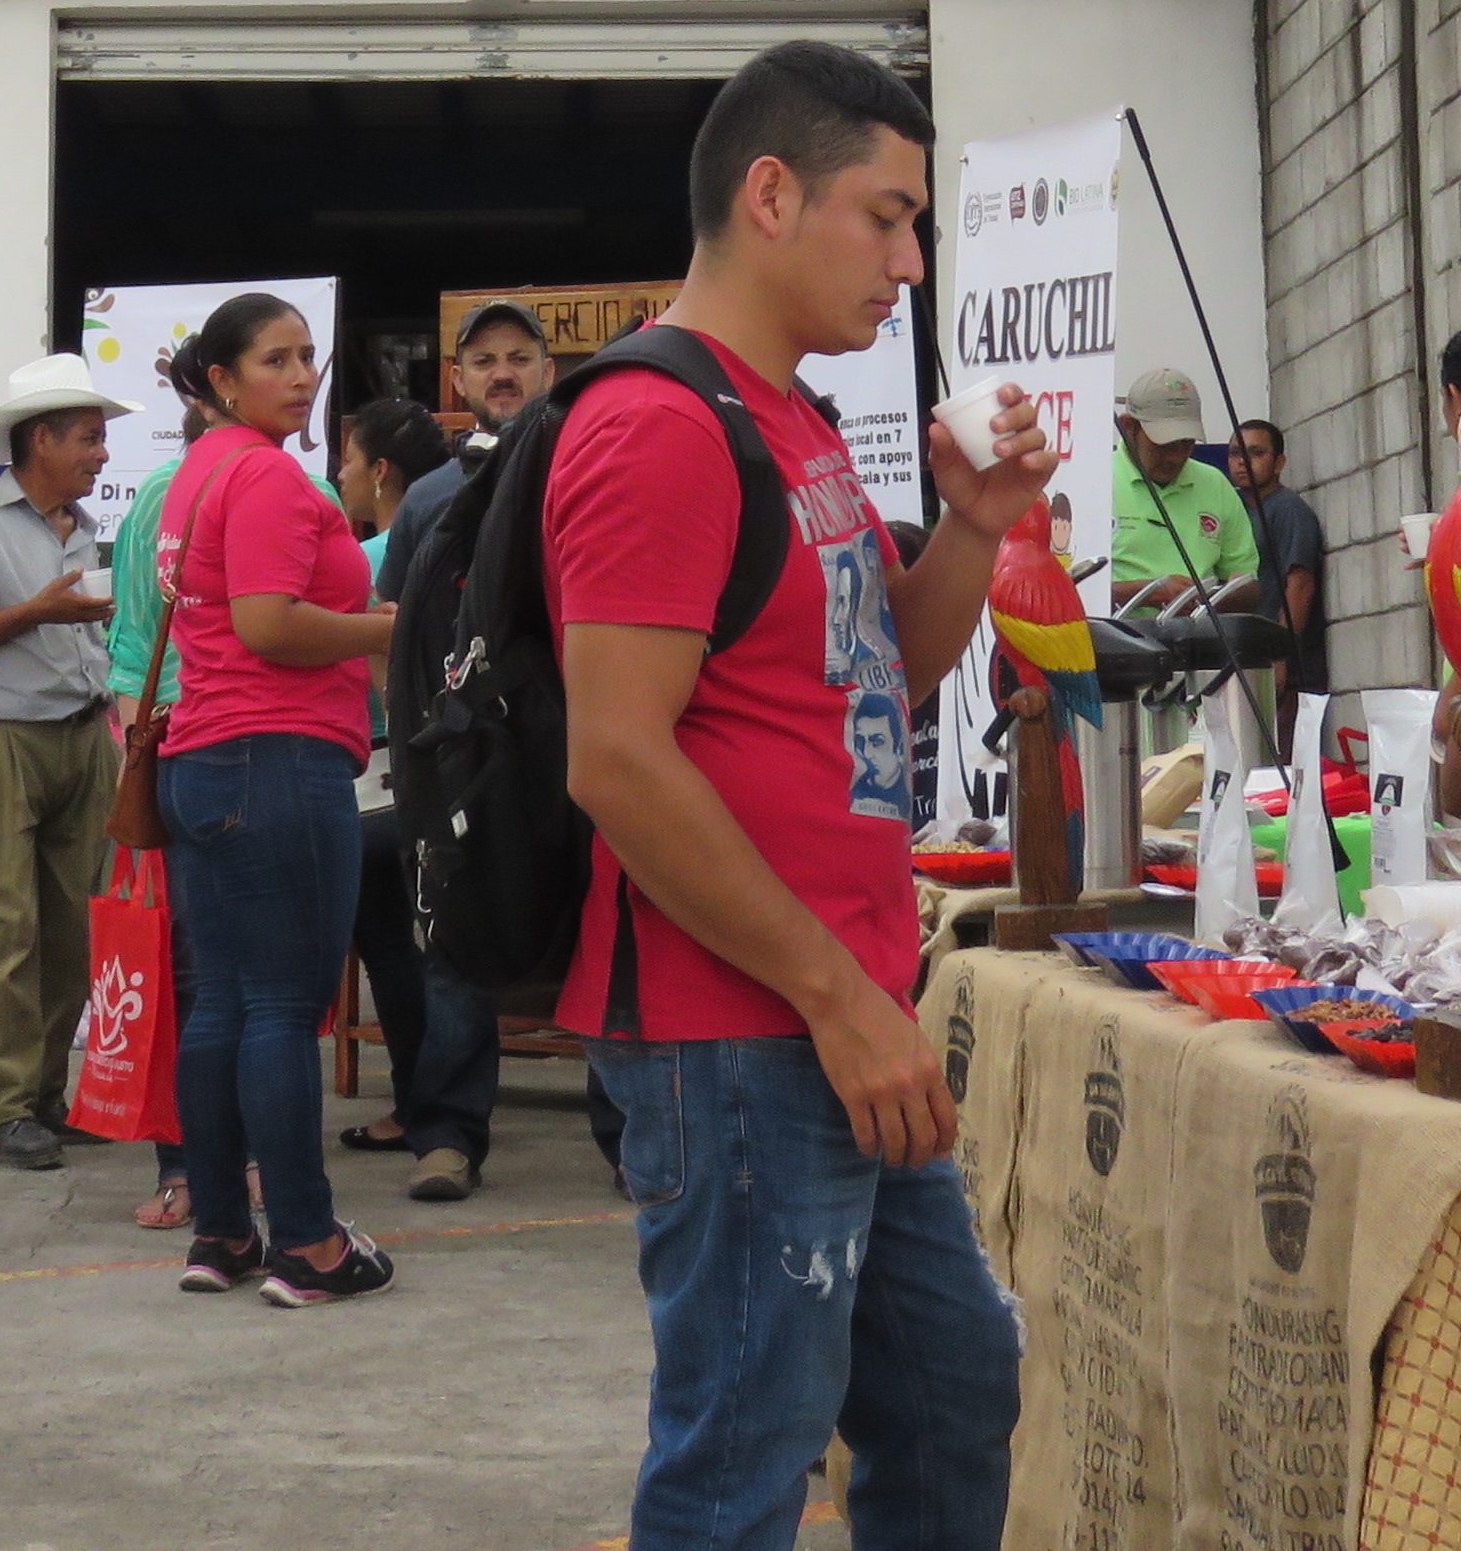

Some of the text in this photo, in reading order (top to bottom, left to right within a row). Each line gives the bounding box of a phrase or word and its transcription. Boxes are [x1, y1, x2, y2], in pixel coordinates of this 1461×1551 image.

[531, 300, 621, 343] ERCIO
[862, 411, 908, 429] procesos
[1022, 391, 1074, 460] CE
[877, 433, 892, 444] en
[895, 429, 902, 443] 7
[858, 453, 876, 465] con
[879, 451, 913, 466] apoyo
[883, 475, 890, 486] y
[893, 471, 912, 483] sus
[101, 484, 137, 501] Di n
